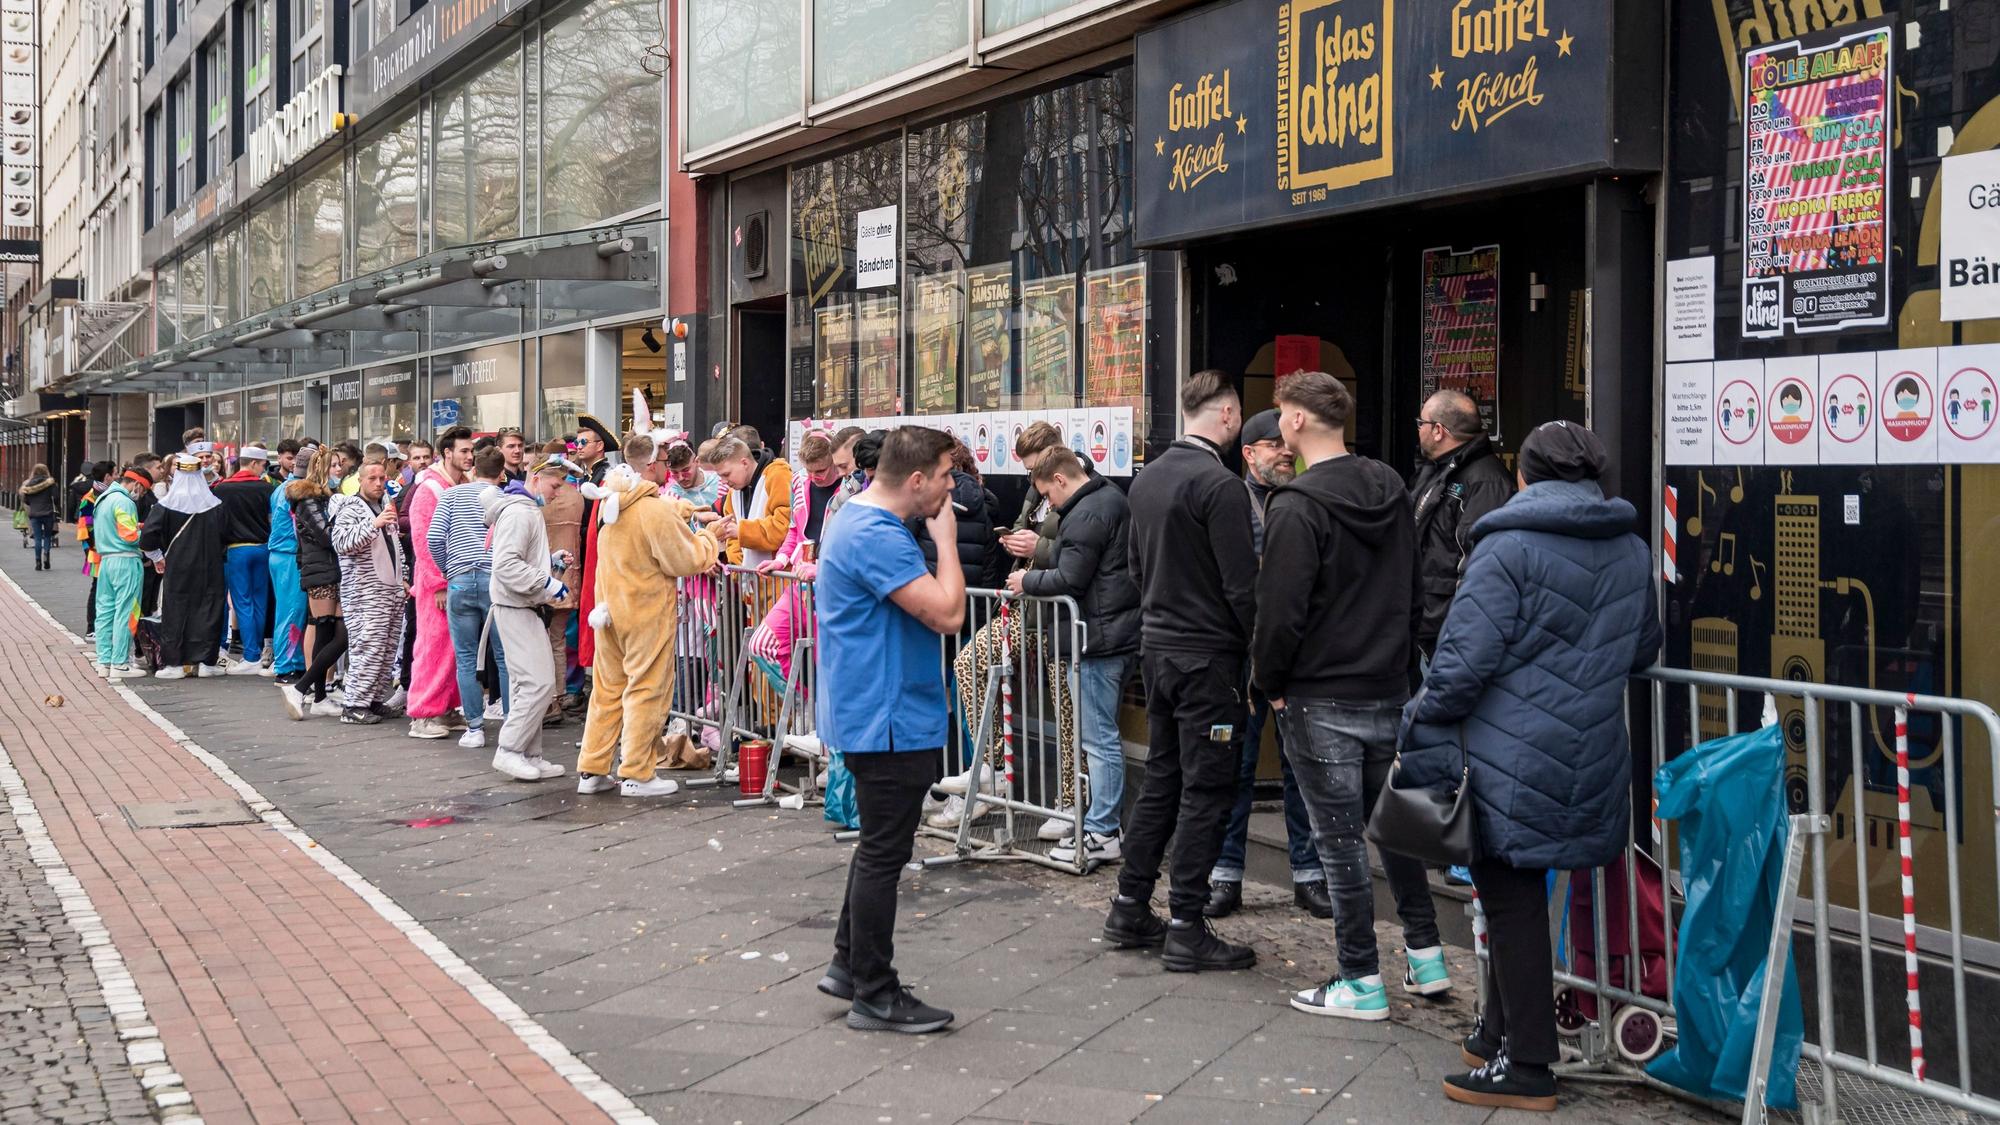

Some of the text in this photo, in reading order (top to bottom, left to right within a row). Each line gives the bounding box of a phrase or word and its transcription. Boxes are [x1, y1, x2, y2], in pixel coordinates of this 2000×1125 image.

[1451, 0, 1549, 59] Gaffel
[1325, 14, 1375, 68] das
[1751, 42, 1884, 91] KÖLLE ALAAF!
[1301, 21, 1381, 149] ding
[1451, 55, 1544, 133] Kölsch
[1169, 69, 1232, 132] Gaffel
[1278, 2, 1290, 190] STUDENTENCLUB
[1752, 103, 1768, 116] DO
[1774, 117, 1790, 129] UHR
[1813, 117, 1883, 143] RUM COLA
[1751, 138, 1763, 151] FR
[1169, 132, 1228, 192] Kölsch
[1774, 152, 1790, 163] UHR
[1791, 155, 1882, 181] WHISKY COLA
[1752, 172, 1764, 185] SA
[1292, 188, 1326, 205] SEIT 1968
[1774, 187, 1790, 198] UHR
[1778, 189, 1882, 219] WODKA ENERGY
[1751, 207, 1764, 220] SO
[861, 223, 892, 238] Gäste ohne
[1774, 221, 1790, 232] UHR
[1751, 239, 1768, 253] MO
[1780, 225, 1882, 253] WODKA LEMON
[858, 257, 894, 274] Bändchen
[1774, 256, 1790, 267] UHR
[972, 283, 1009, 303] SAMSTAG
[1564, 290, 1578, 390] STUDENTENCLUB
[452, 358, 498, 386] WHO'S PERFECT.
[987, 368, 1000, 380] COLA
[1686, 426, 1702, 434] Maske
